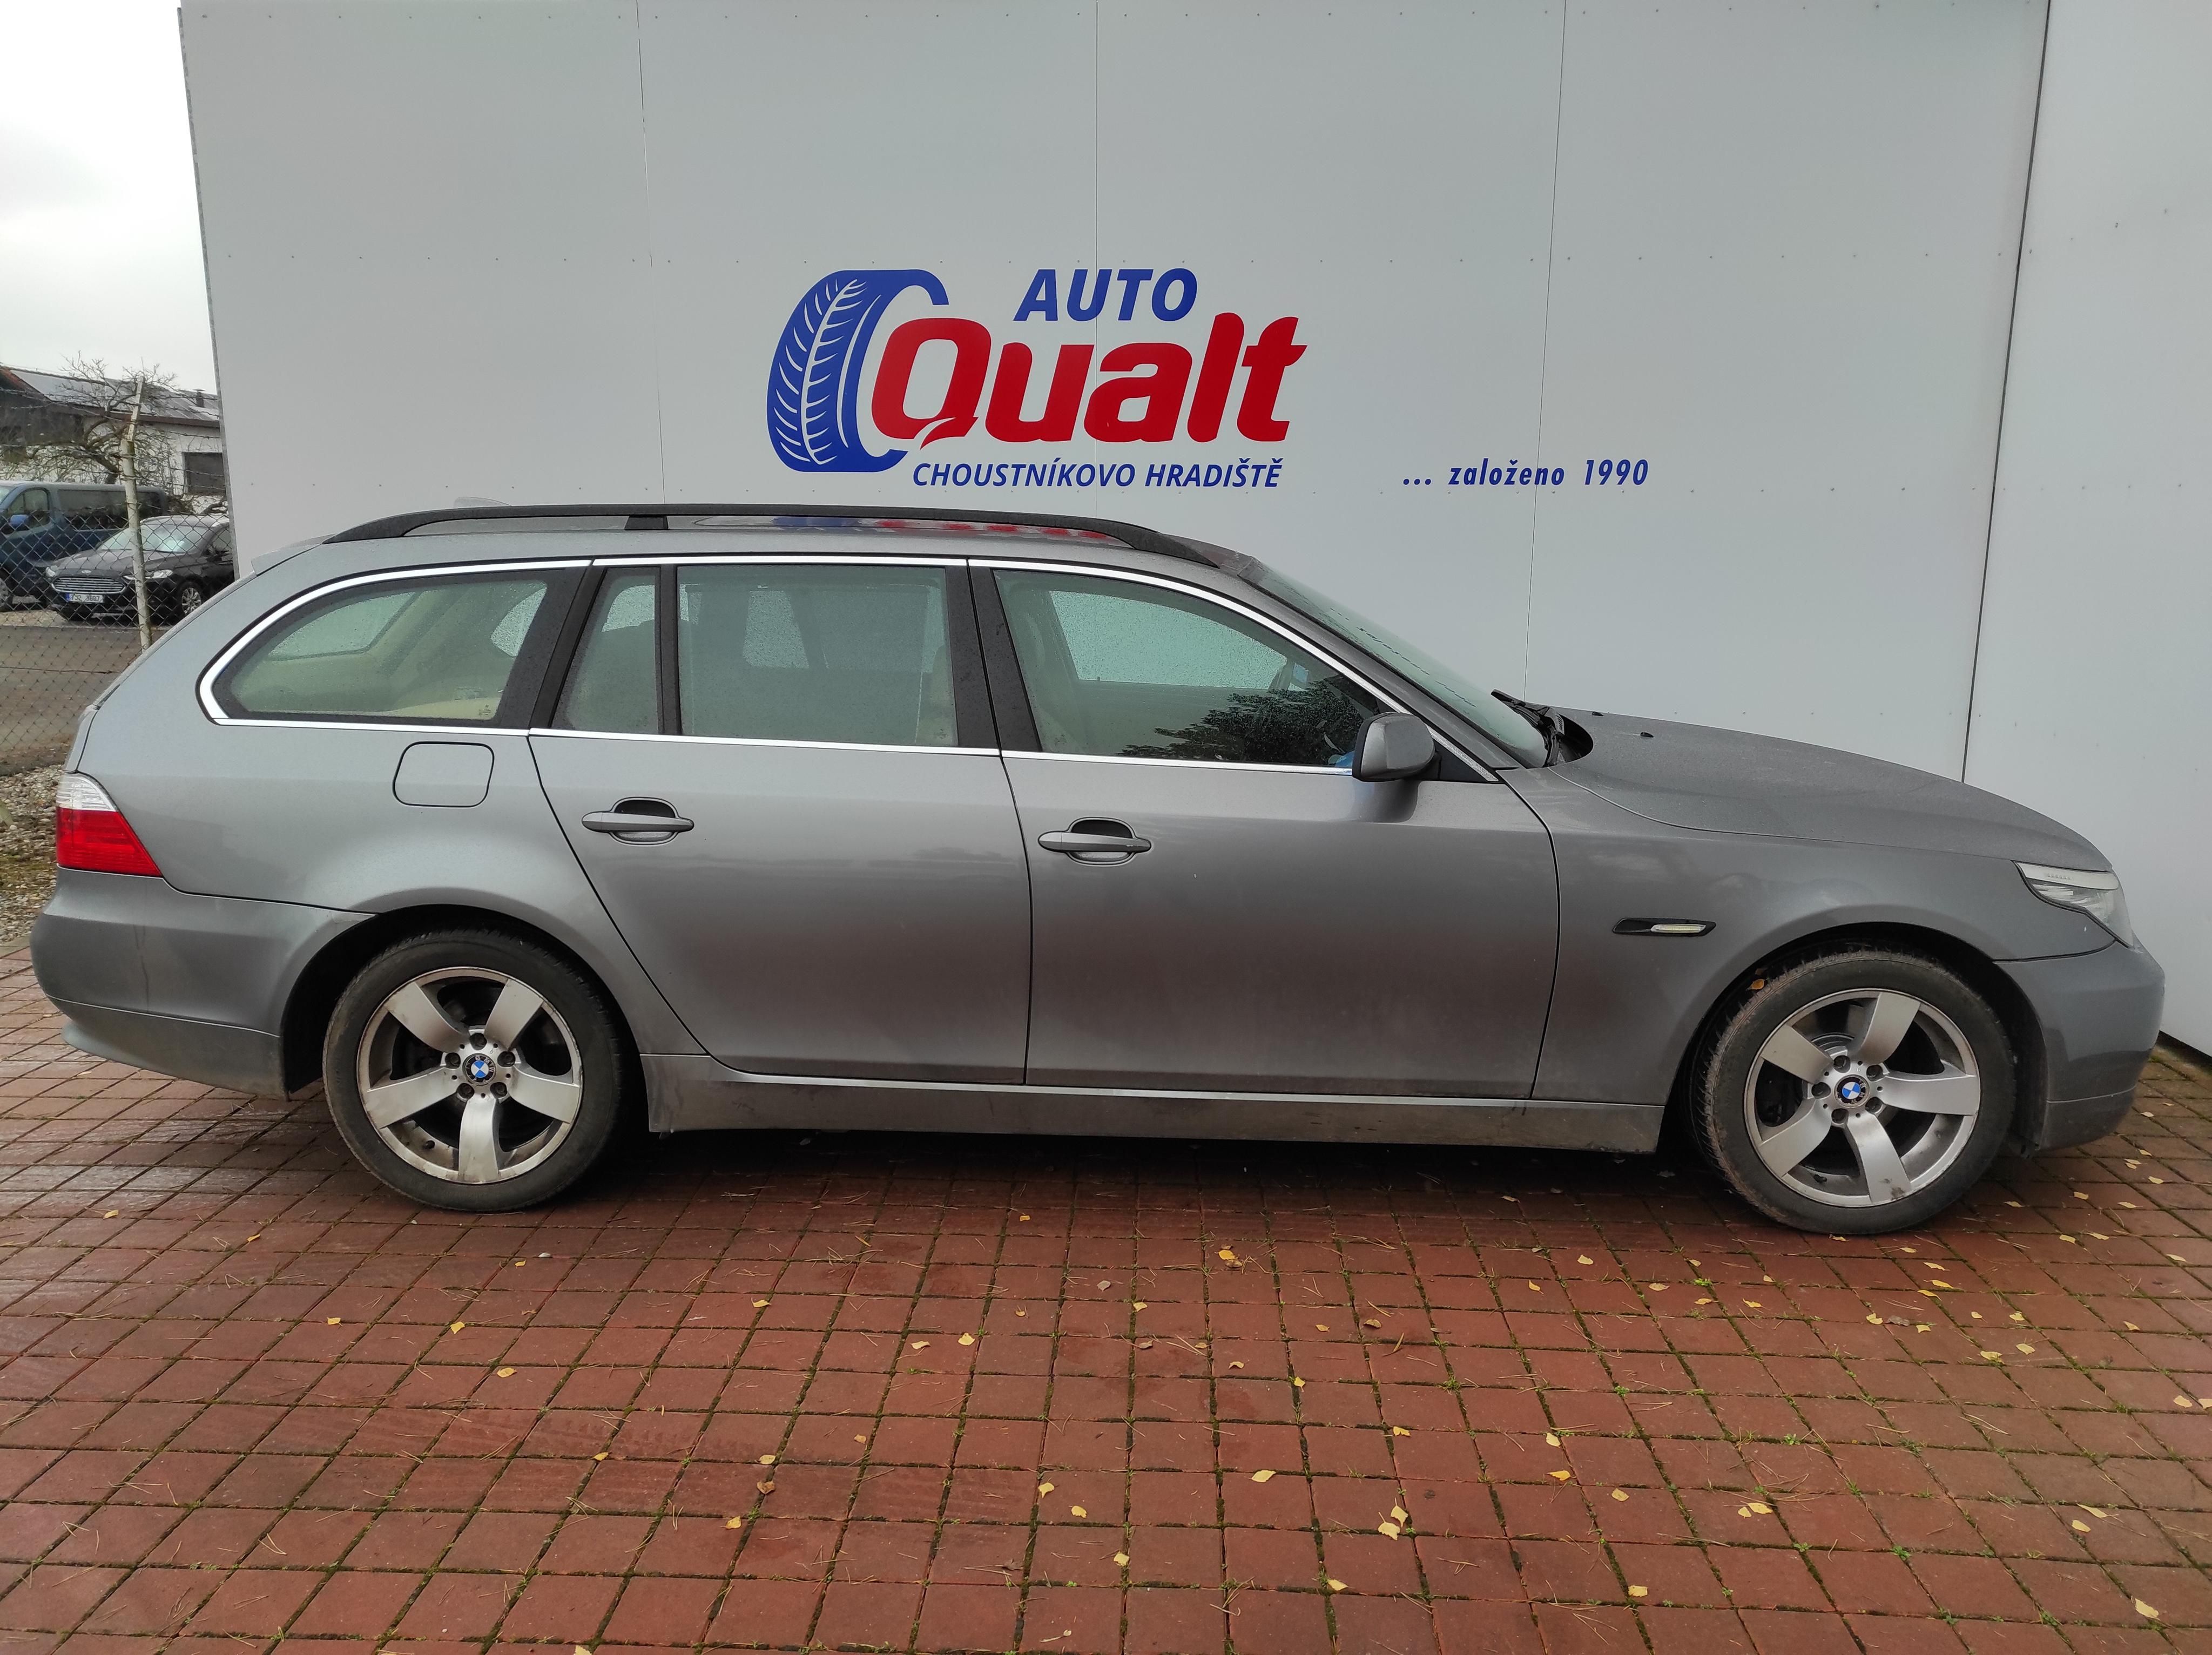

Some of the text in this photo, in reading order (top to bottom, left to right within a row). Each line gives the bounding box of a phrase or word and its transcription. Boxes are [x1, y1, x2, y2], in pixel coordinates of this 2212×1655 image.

[1013, 268, 1198, 322] AUTO
[871, 312, 1307, 450] Qualt
[912, 457, 1283, 488] CHOUSTNÍKOVO HRADIŠTĚ
[1448, 458, 1565, 485] založeno
[1584, 459, 1649, 485] 1990
[475, 1055, 495, 1072] BMW
